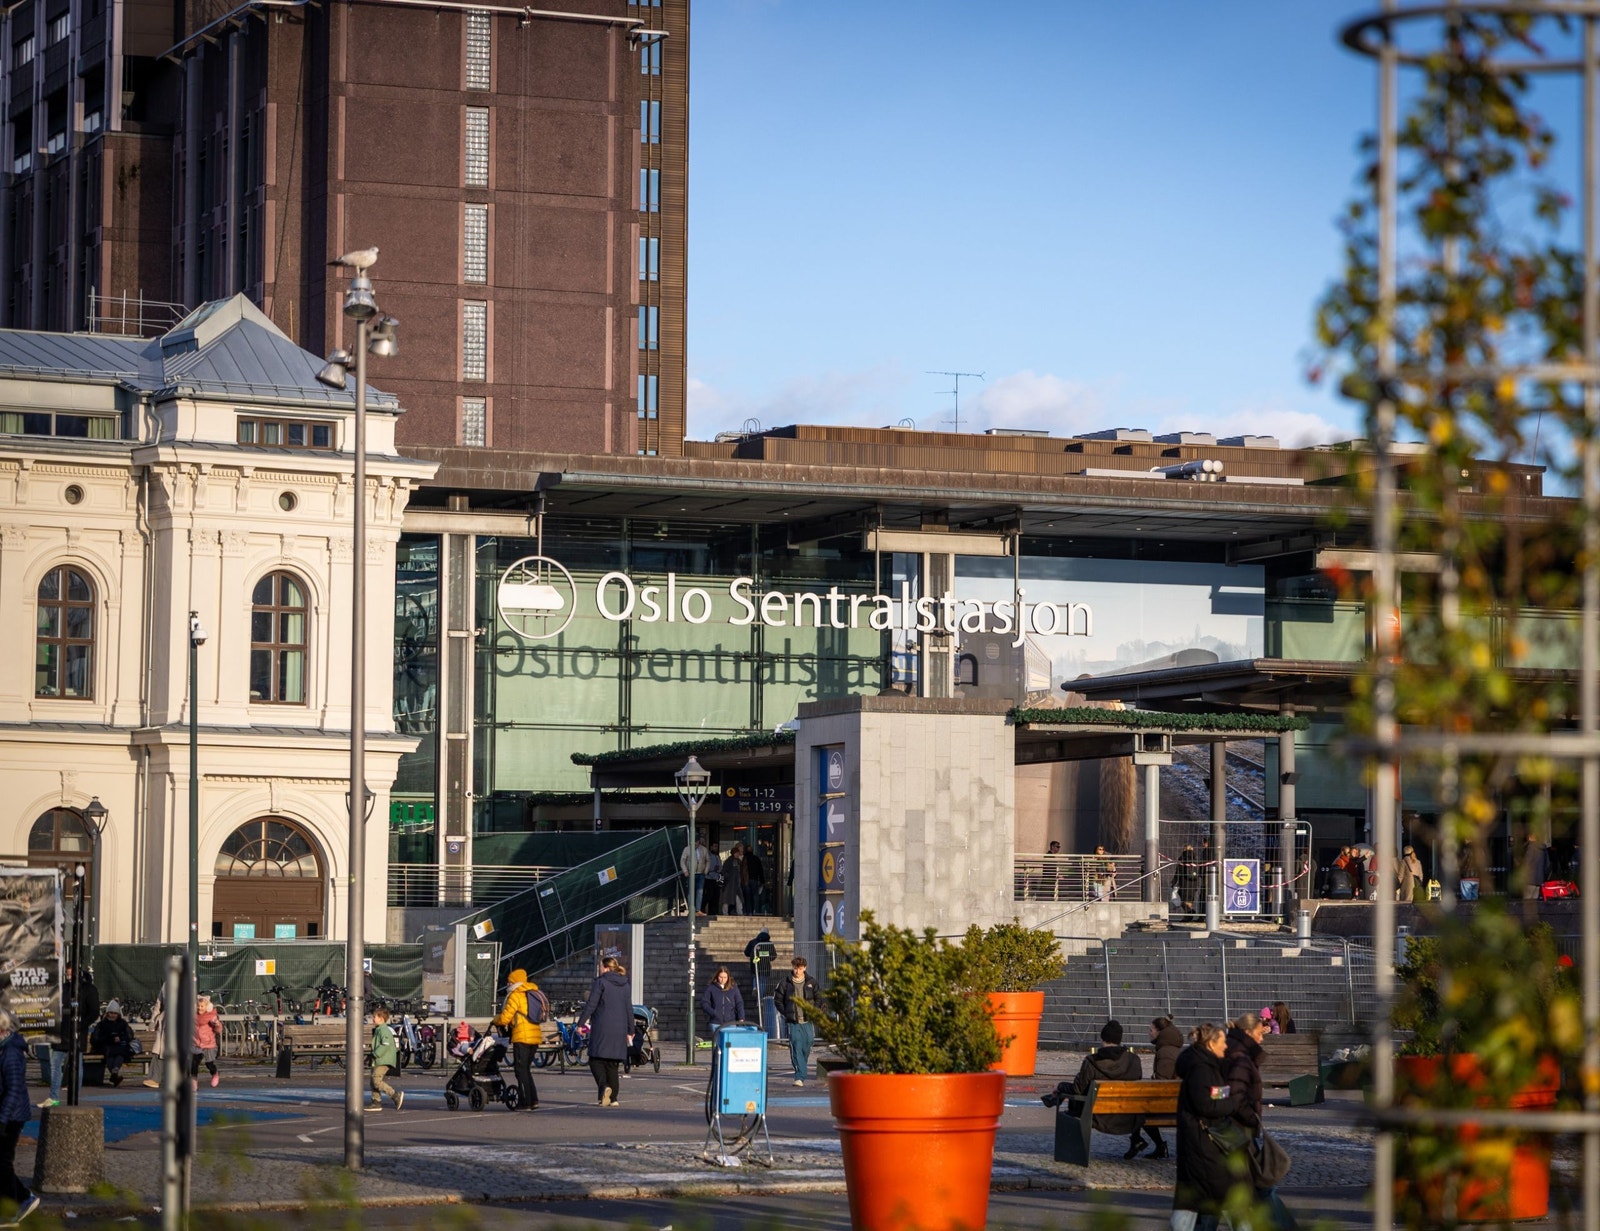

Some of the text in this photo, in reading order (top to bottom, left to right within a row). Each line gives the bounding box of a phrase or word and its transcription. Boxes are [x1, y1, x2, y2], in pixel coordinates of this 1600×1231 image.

[596, 571, 1094, 648] Oslo Sentralstasjon
[754, 788, 775, 798] 1-12
[754, 802, 781, 812] 13-19
[10, 967, 48, 976] STAR
[10, 975, 49, 986] WARS
